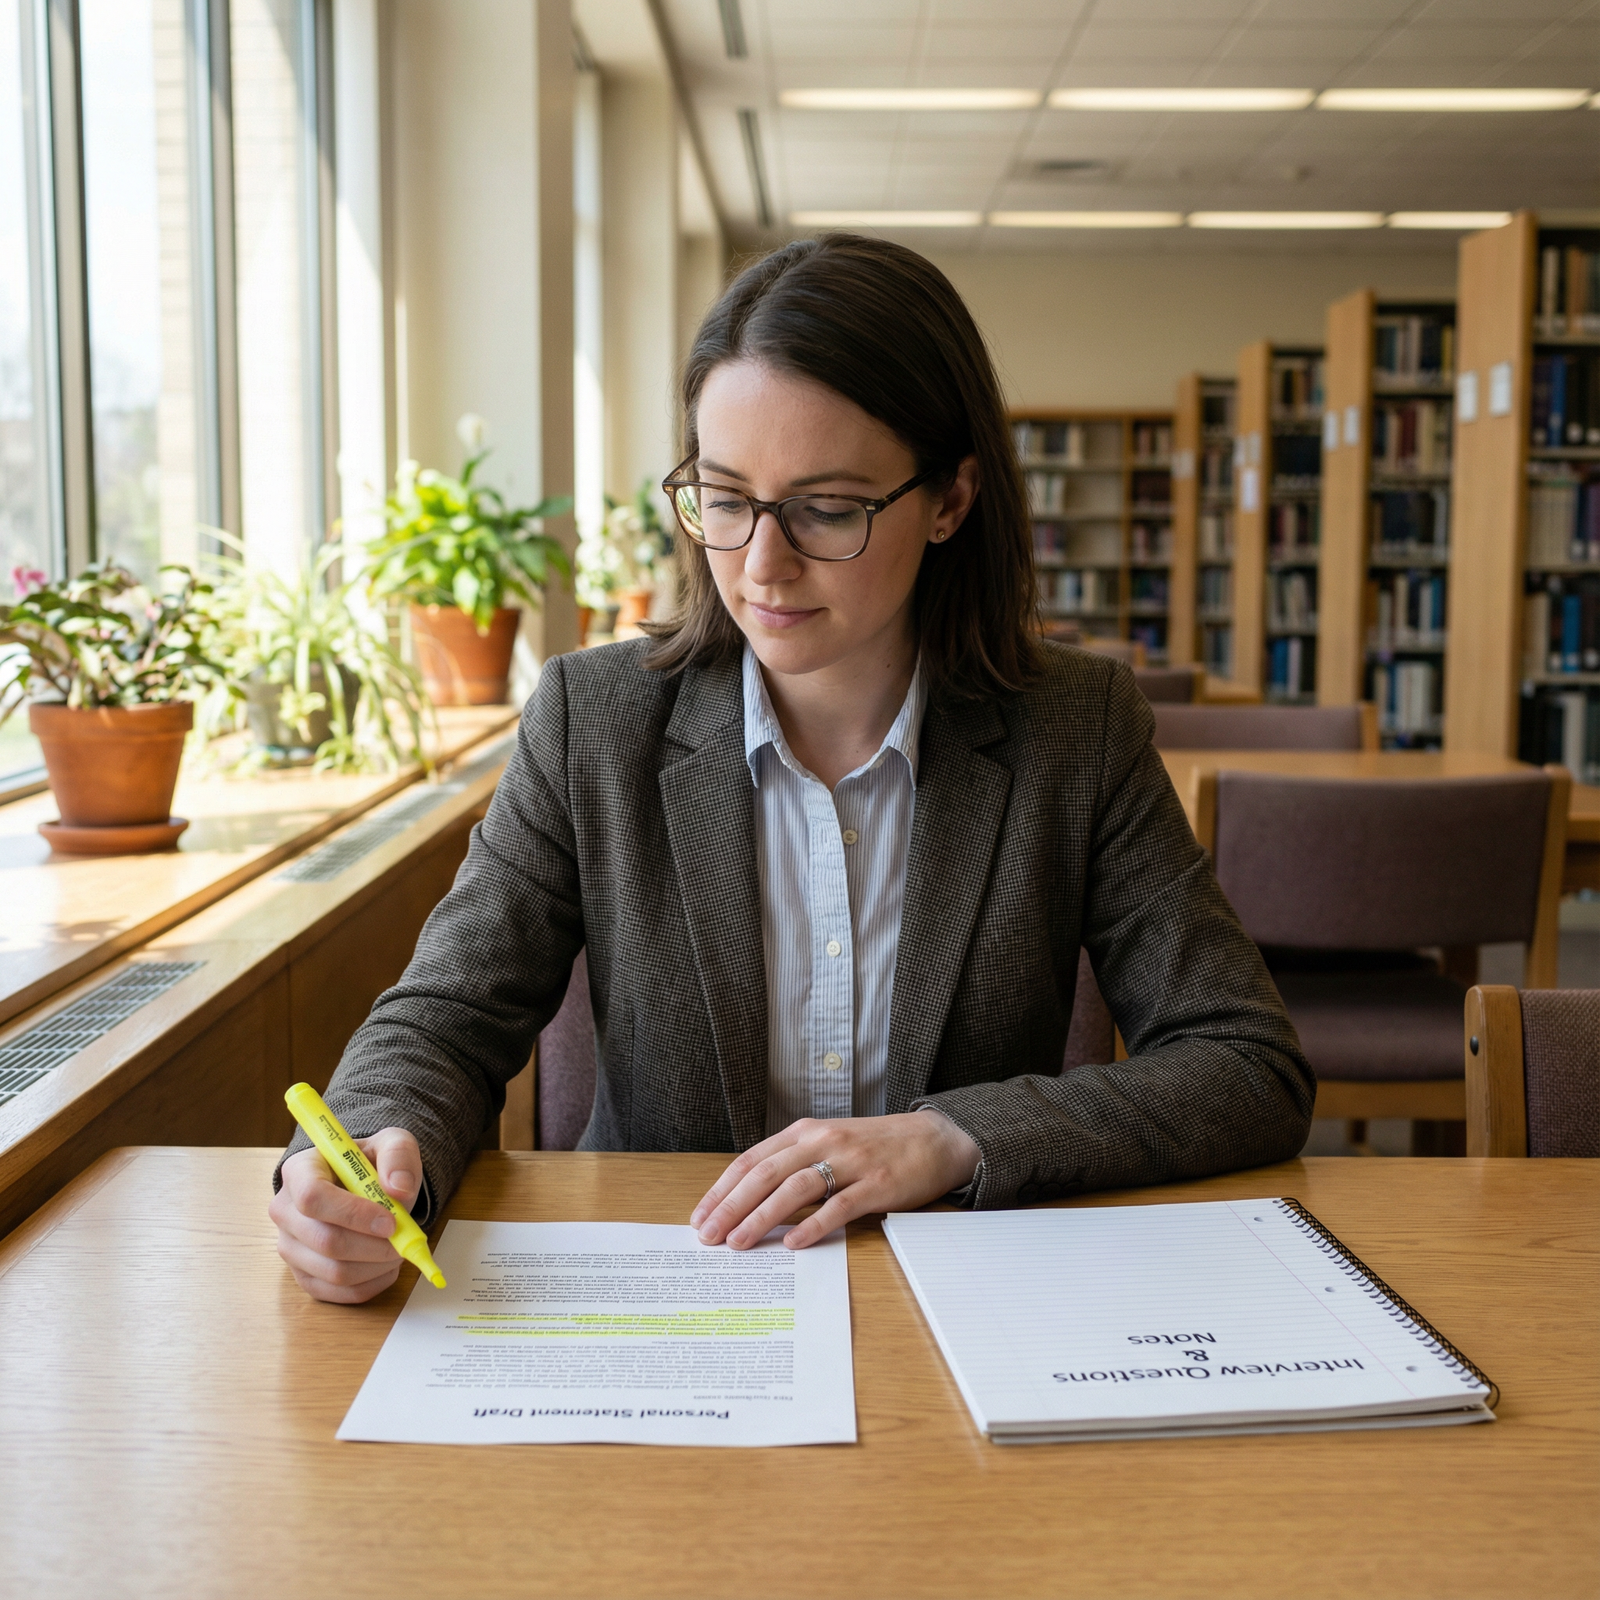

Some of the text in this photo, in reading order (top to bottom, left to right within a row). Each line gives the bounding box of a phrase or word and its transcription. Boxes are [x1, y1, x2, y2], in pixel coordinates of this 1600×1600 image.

[1127, 1332, 1217, 1345] Notes
[1183, 1349, 1210, 1362] &
[1052, 1358, 1365, 1383] Interview Questions
[473, 1407, 730, 1420] Personal Statement Draft
